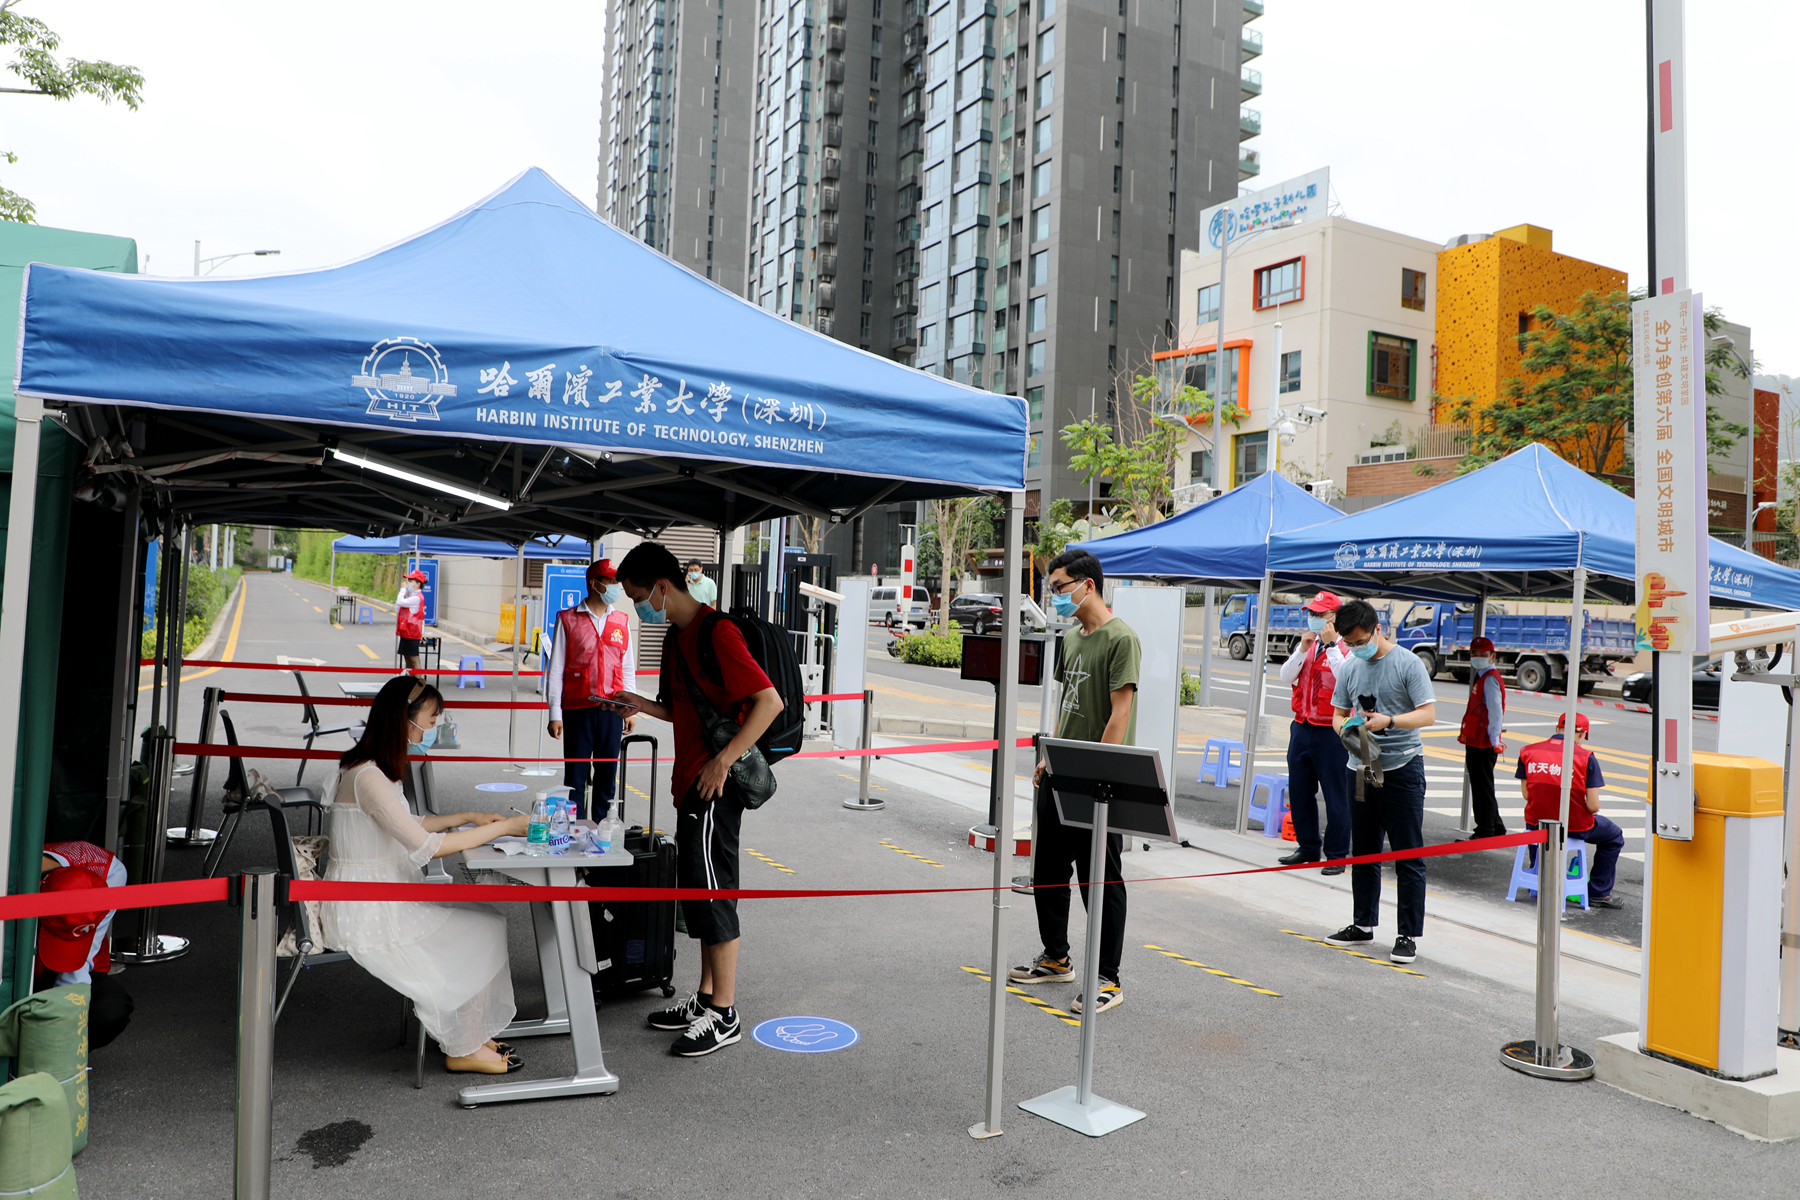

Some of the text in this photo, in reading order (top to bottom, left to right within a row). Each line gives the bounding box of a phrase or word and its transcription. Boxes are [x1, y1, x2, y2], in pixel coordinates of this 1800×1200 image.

[1679, 301, 1689, 406] 同在一方热土 共建文明家园
[386, 402, 420, 412] HIT
[476, 407, 824, 454] HARBIN INSTITUTE OF TECHNOLOGY, SHENZHEN
[1655, 319, 1674, 553] 全力争创第六届 全国文明城市
[1733, 589, 1751, 597] SHENZHEN
[1527, 762, 1574, 779] 航天物
